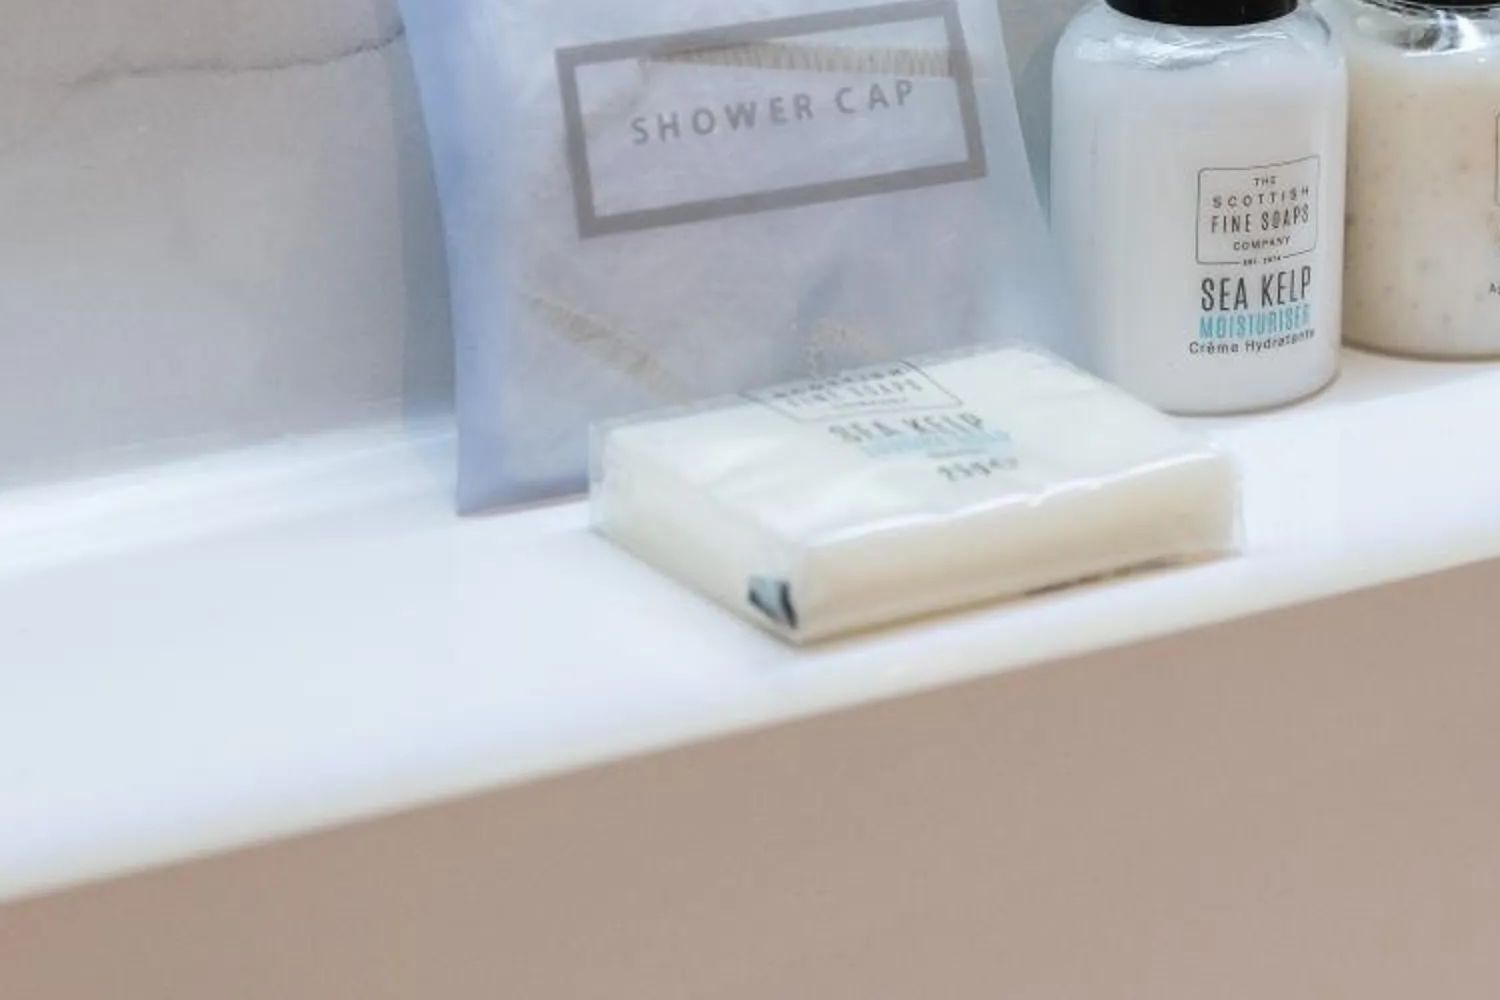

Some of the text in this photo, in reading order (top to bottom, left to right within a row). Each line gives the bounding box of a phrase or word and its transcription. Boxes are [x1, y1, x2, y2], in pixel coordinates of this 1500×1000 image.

[631, 78, 915, 146] SHOWER CAP
[1212, 185, 1310, 209] SCOTTISH
[1253, 175, 1277, 187] THE
[1210, 202, 1310, 234] FINE SOAPS
[1201, 264, 1312, 313] SEA KELP
